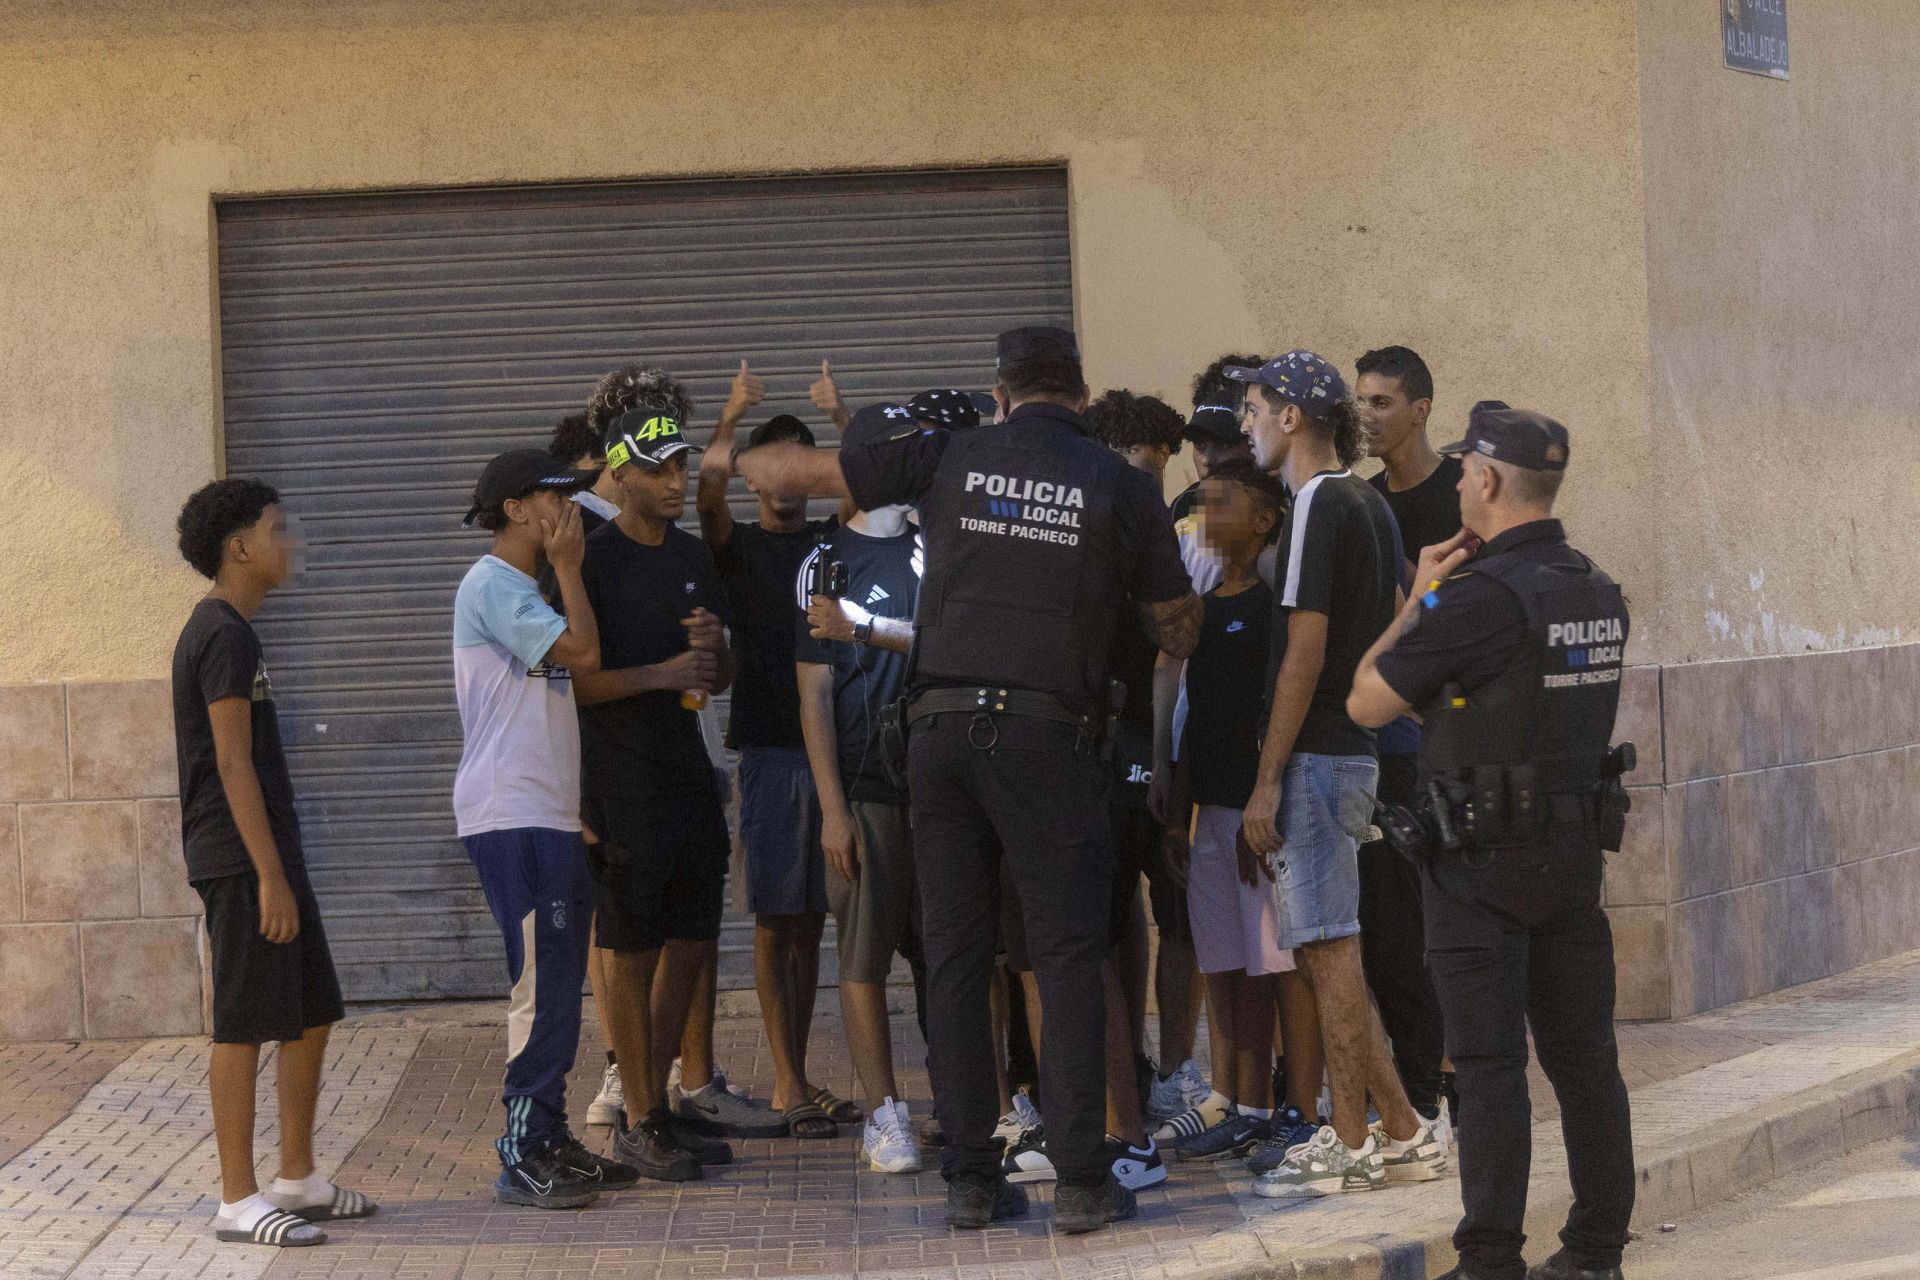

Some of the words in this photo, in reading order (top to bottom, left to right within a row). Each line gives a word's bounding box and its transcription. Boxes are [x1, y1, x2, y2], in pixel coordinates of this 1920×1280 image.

[1727, 28, 1787, 66] ALBALADEJO
[635, 416, 679, 442] 46
[965, 472, 1084, 509] POLICIA
[1022, 505, 1081, 528] LOCAL
[960, 517, 1007, 535] TORRE
[1010, 525, 1079, 546] PACHECO
[1547, 618, 1623, 647] POLICIA
[1588, 645, 1621, 665] LOCAL
